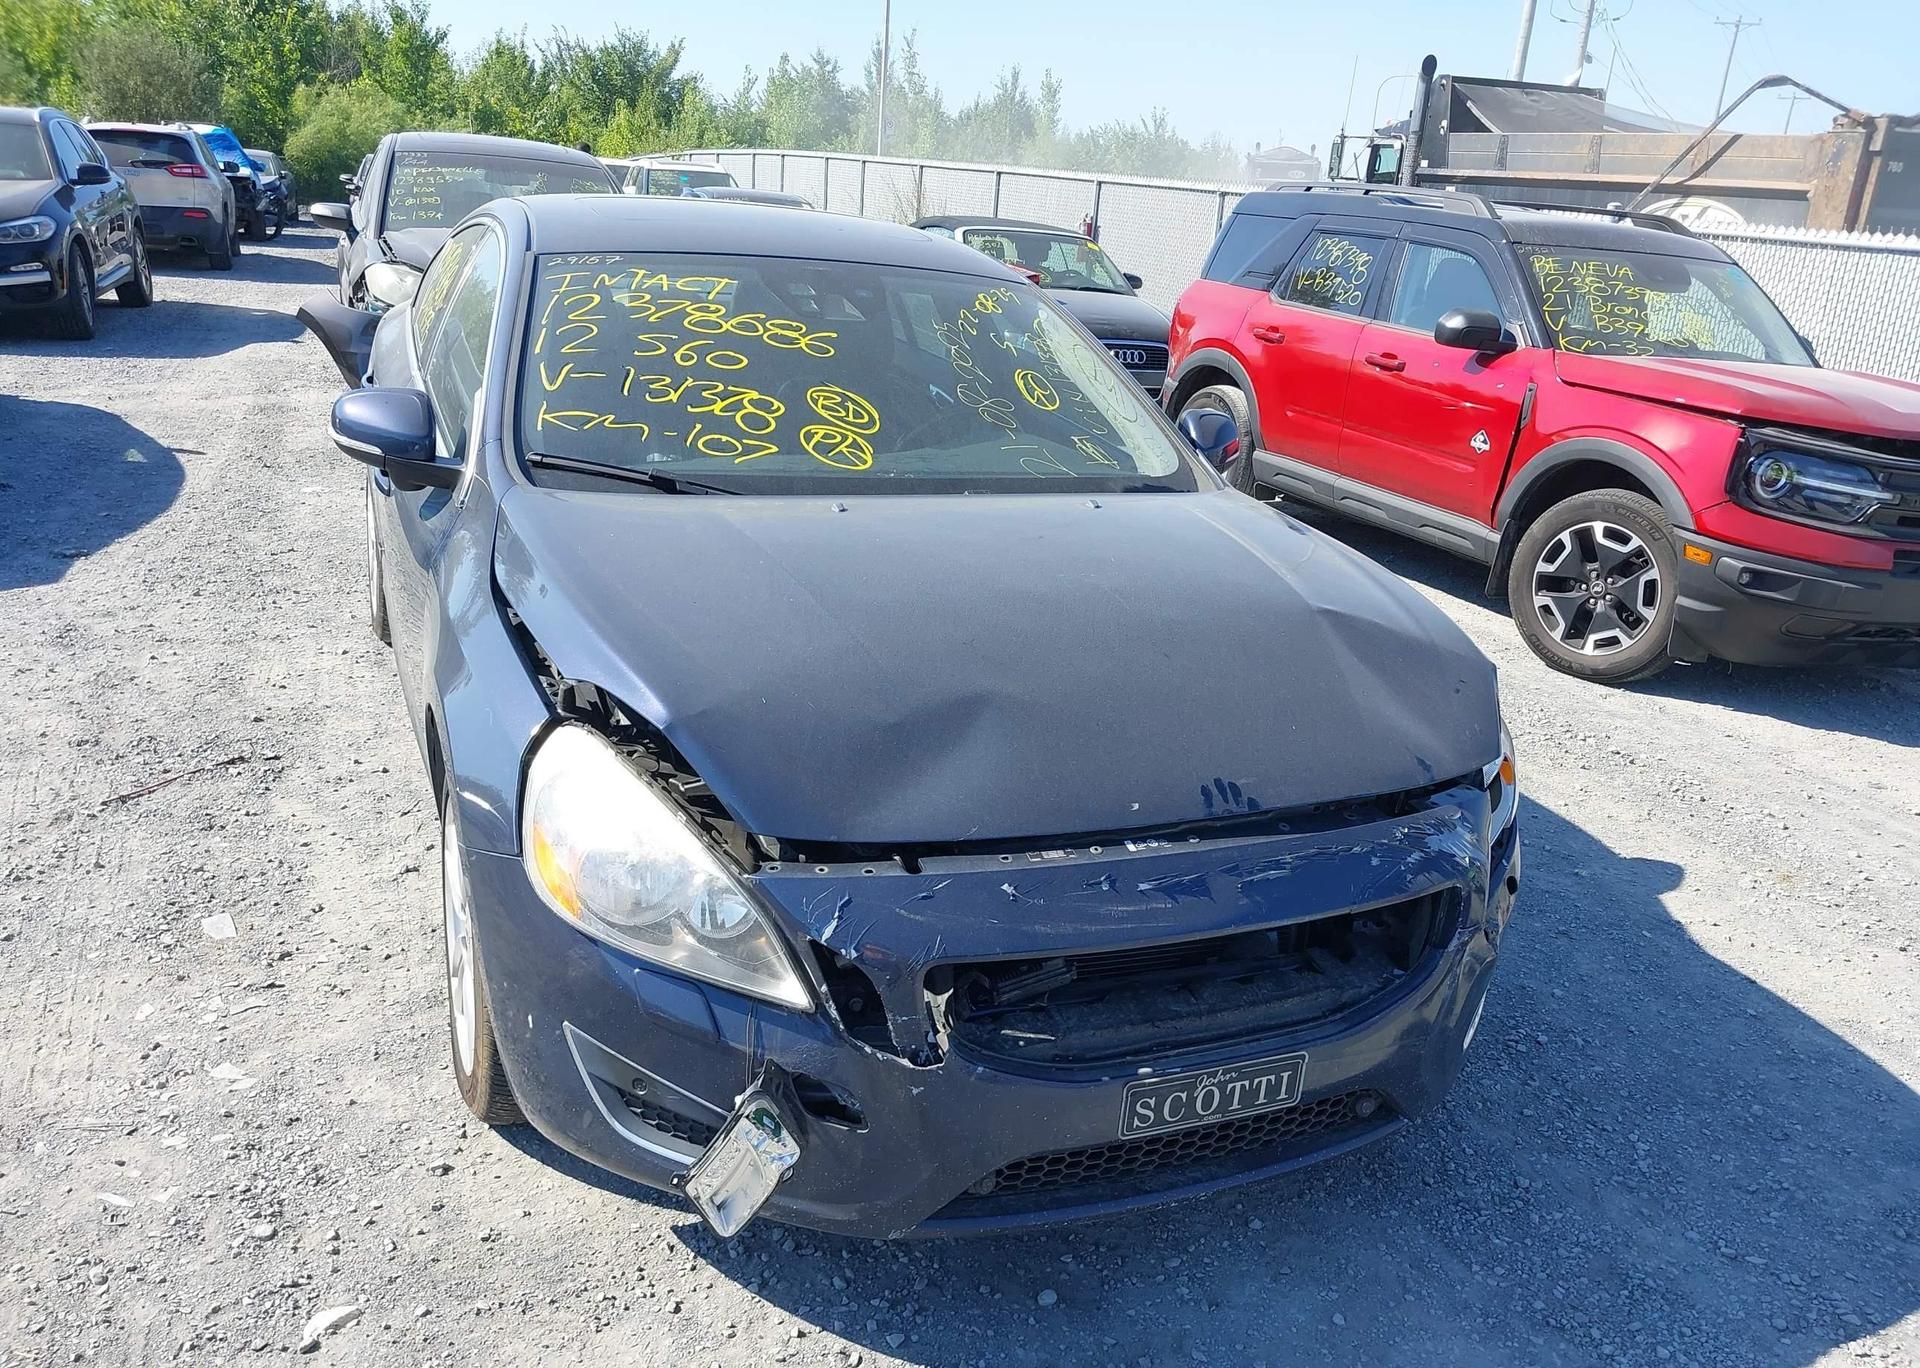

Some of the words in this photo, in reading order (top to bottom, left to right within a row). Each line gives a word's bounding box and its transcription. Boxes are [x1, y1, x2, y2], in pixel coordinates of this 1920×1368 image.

[545, 268, 739, 300] INTACT
[534, 323, 600, 354] 12
[541, 293, 838, 358] 12378686
[1194, 1069, 1239, 1097] John
[1133, 1071, 1292, 1129] SCOTTI
